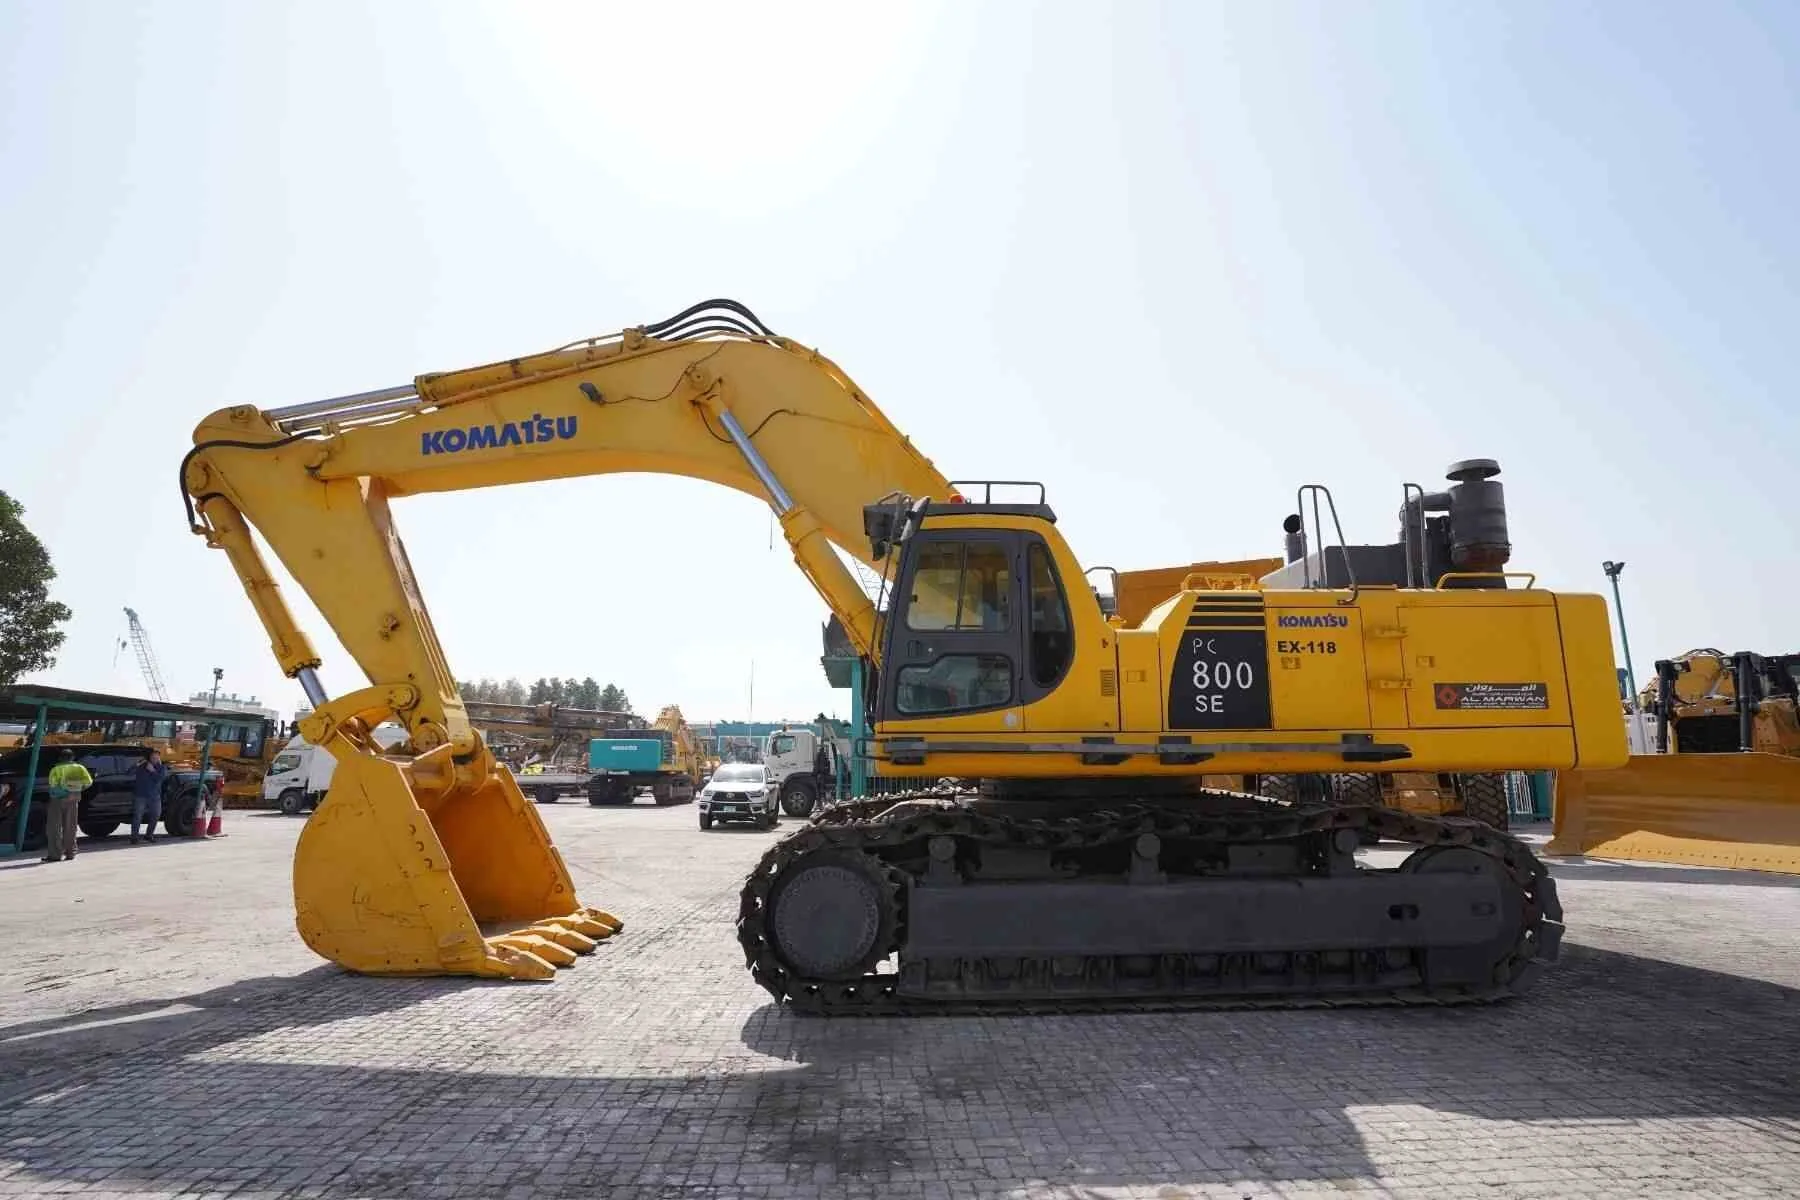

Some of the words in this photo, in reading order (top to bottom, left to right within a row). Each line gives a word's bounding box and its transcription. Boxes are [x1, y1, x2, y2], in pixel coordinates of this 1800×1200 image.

[422, 413, 577, 455] KOMATSU
[1277, 614, 1348, 627] KOMATSU
[1277, 641, 1337, 654] EX-118
[1192, 661, 1253, 689] 800
[1194, 695, 1225, 713] SE
